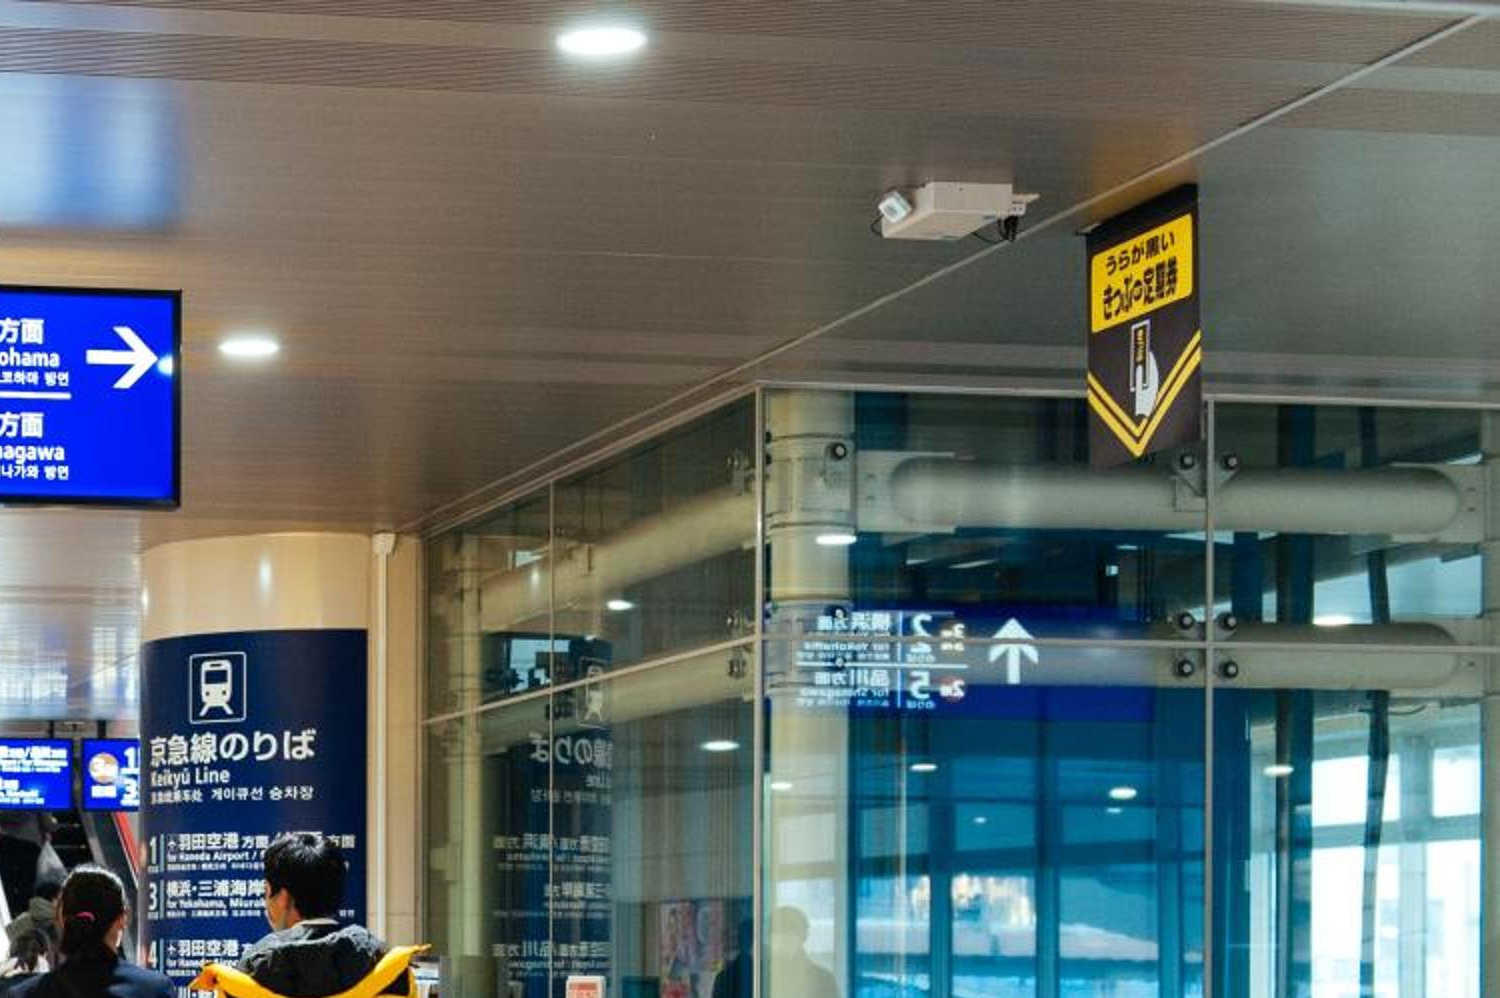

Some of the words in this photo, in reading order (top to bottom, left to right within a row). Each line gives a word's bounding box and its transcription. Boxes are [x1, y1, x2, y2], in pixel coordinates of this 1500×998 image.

[151, 728, 317, 768] 京急線のりば
[195, 766, 231, 785] Line
[149, 836, 158, 866] 1
[213, 850, 250, 863] Airport
[148, 882, 158, 912] 3
